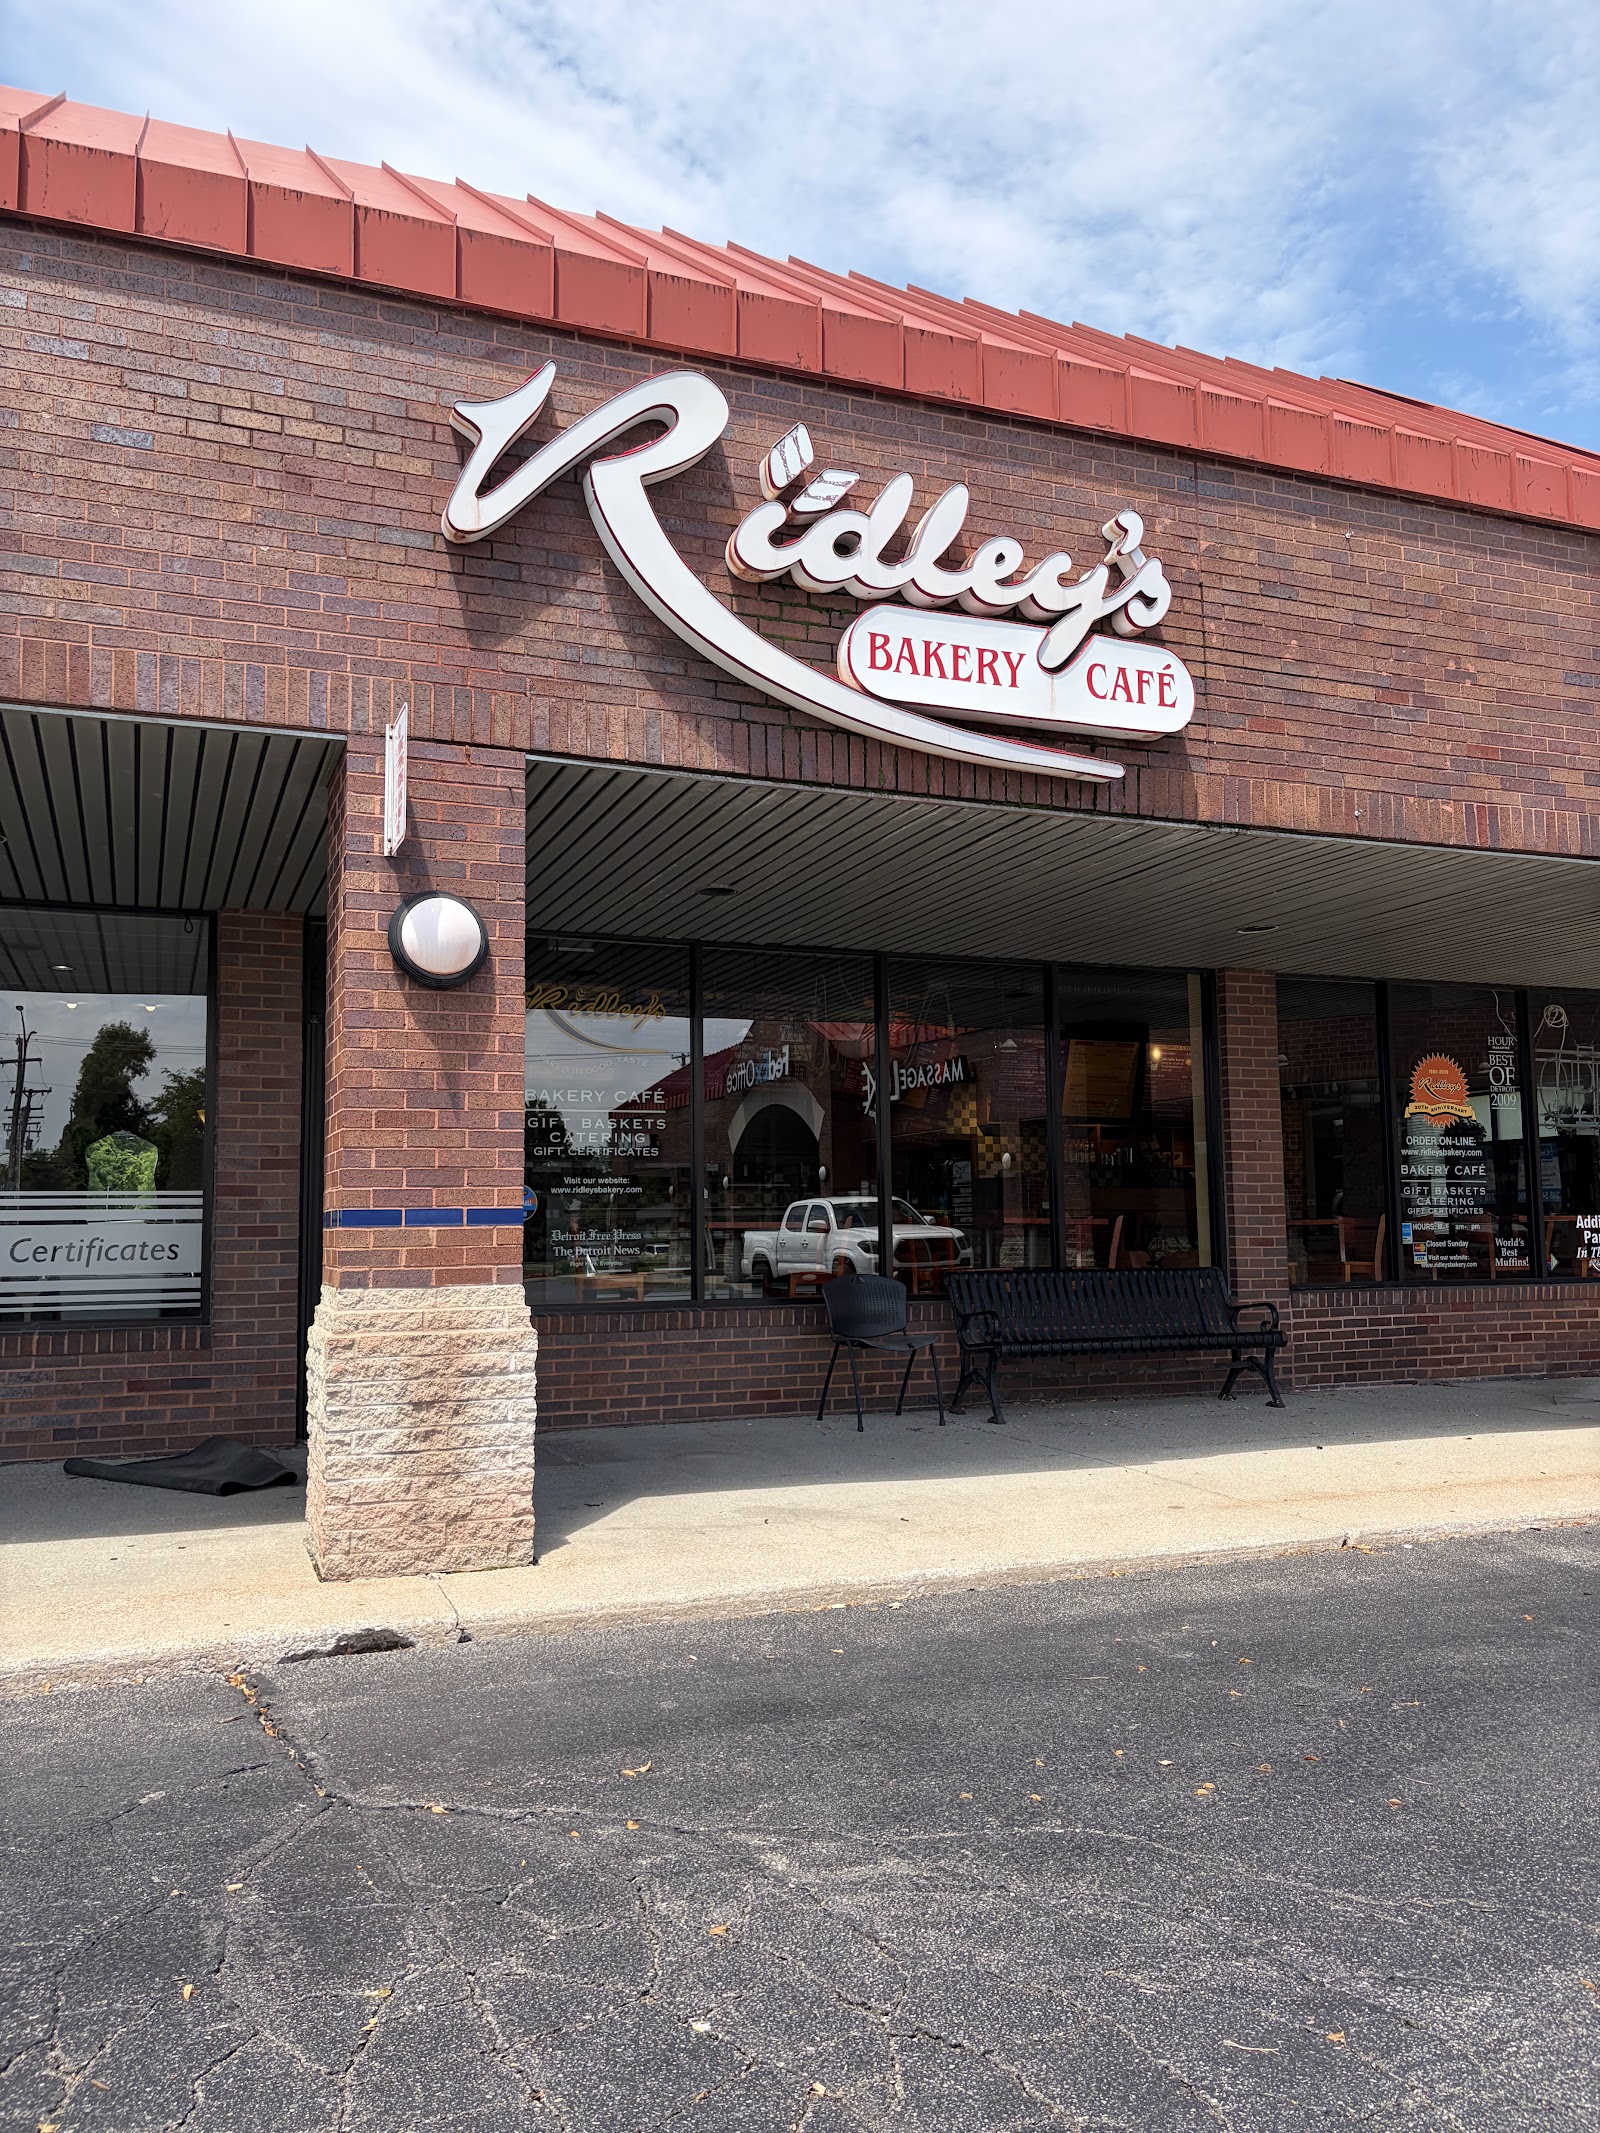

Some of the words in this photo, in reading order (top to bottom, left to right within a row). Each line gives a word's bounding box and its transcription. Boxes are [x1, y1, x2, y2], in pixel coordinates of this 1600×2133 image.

[441, 360, 1173, 782] Ridley's
[868, 631, 1027, 689] BAKERY
[1086, 662, 1178, 709] CAFÉ
[1487, 1035, 1515, 1046] HOUR
[539, 1053, 569, 1074] BAKED
[572, 1067, 583, 1075] IN
[585, 1060, 613, 1074] GOOD
[617, 1056, 649, 1067] TASTE
[1489, 1054, 1515, 1066] BEST
[1489, 1066, 1516, 1086] OF
[1489, 1085, 1517, 1093] DETROIT
[525, 1089, 605, 1103] BAKERY
[614, 1087, 666, 1104] CAFÉ
[1491, 1093, 1517, 1107] 2009
[527, 1117, 571, 1129] GIFT
[582, 1118, 667, 1130] BASKETS
[549, 1132, 646, 1144] CATERING
[1406, 1136, 1437, 1146] ORDER
[1439, 1136, 1477, 1147] ON-LINE:
[533, 1146, 563, 1156] GIFT
[568, 1147, 660, 1157] CERTIFICATES
[1400, 1148, 1483, 1158] www.ridleysbakery.com
[1400, 1164, 1450, 1175] BAKERY
[1454, 1163, 1487, 1176] CAFÉ
[563, 1176, 581, 1185] Visit
[598, 1176, 631, 1186] website:
[550, 1185, 643, 1196] www.ridleysbakery.com
[1403, 1186, 1430, 1195] GIFT
[1435, 1186, 1487, 1196] BASKETS
[1416, 1197, 1475, 1206] CATERING
[1407, 1207, 1425, 1215] GIFT
[1428, 1207, 1484, 1216] CERTIFICATES
[1412, 1222, 1437, 1231] HOURS:
[550, 1229, 586, 1245] Detroit
[586, 1229, 611, 1244] Free
[612, 1228, 642, 1244] Press
[1495, 1237, 1525, 1247] World's
[1426, 1239, 1446, 1247] Closed
[1447, 1239, 1469, 1249] Sunday
[10, 1236, 180, 1267] Certificates
[552, 1246, 574, 1257] The
[575, 1245, 612, 1257] Detroit
[613, 1245, 641, 1256] News
[1501, 1247, 1518, 1257] Best
[1576, 1246, 1588, 1259] In
[1495, 1255, 1530, 1267] Muffins!
